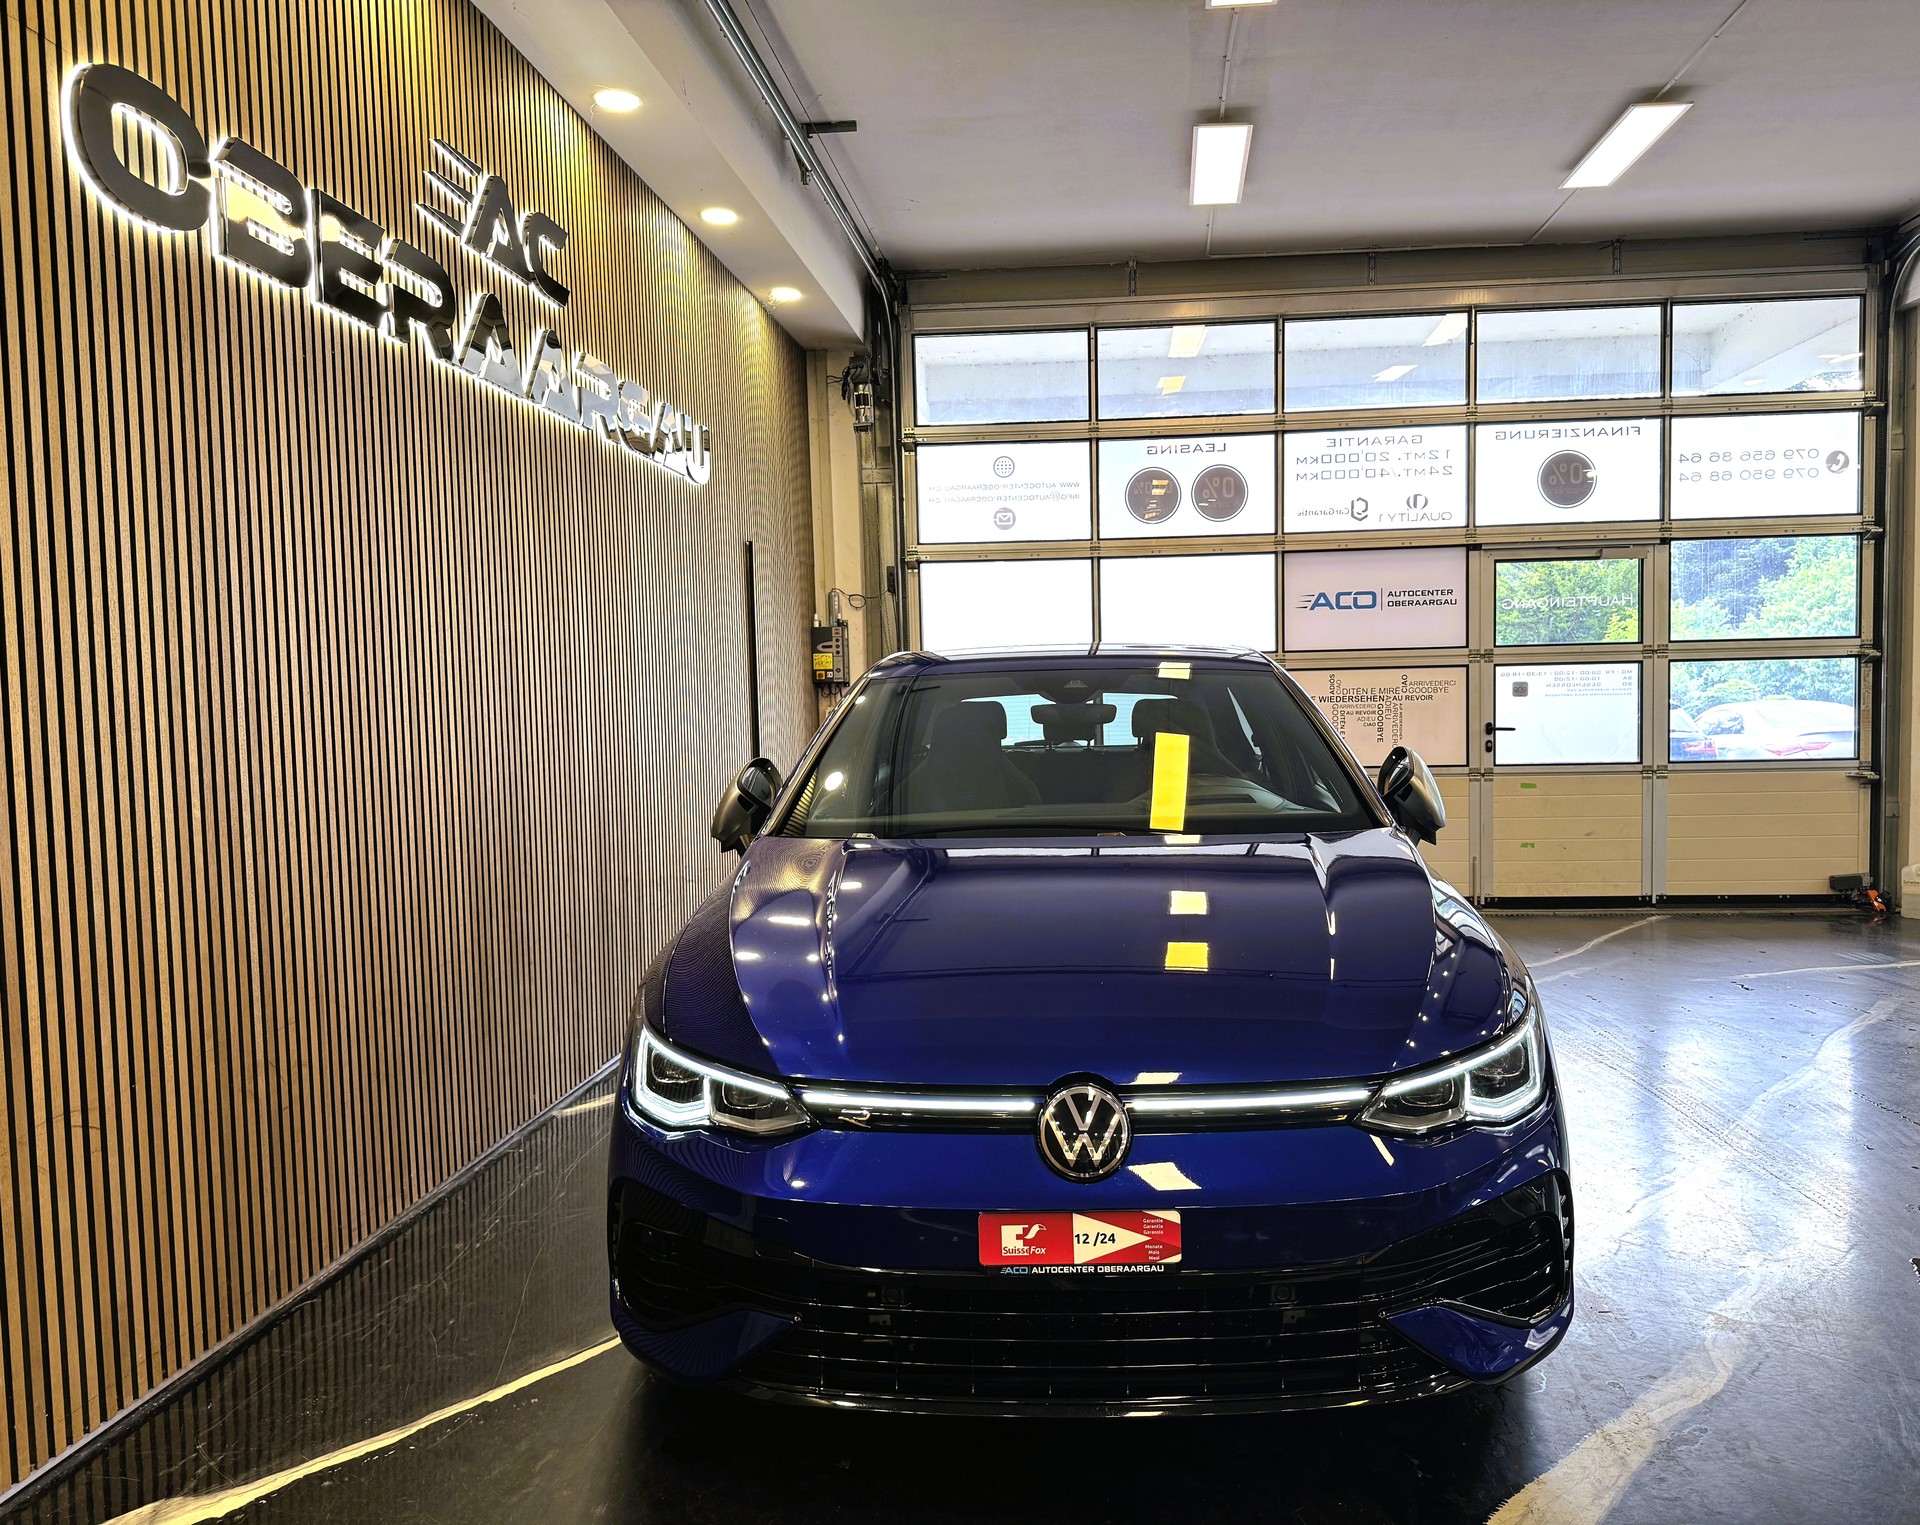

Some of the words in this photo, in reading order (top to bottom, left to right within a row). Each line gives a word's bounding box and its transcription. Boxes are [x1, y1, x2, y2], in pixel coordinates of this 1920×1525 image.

[64, 62, 711, 485] OBERAARGAU
[1387, 589, 1453, 598] AUTOCENTER
[1309, 591, 1377, 610] ACO
[1387, 598, 1457, 608] OBERAARGAU
[1318, 695, 1385, 703] WIEDERSEHEN
[1074, 1233, 1090, 1244] 12
[1093, 1232, 1116, 1246] /24
[1032, 1266, 1095, 1274] AUTOCENTER
